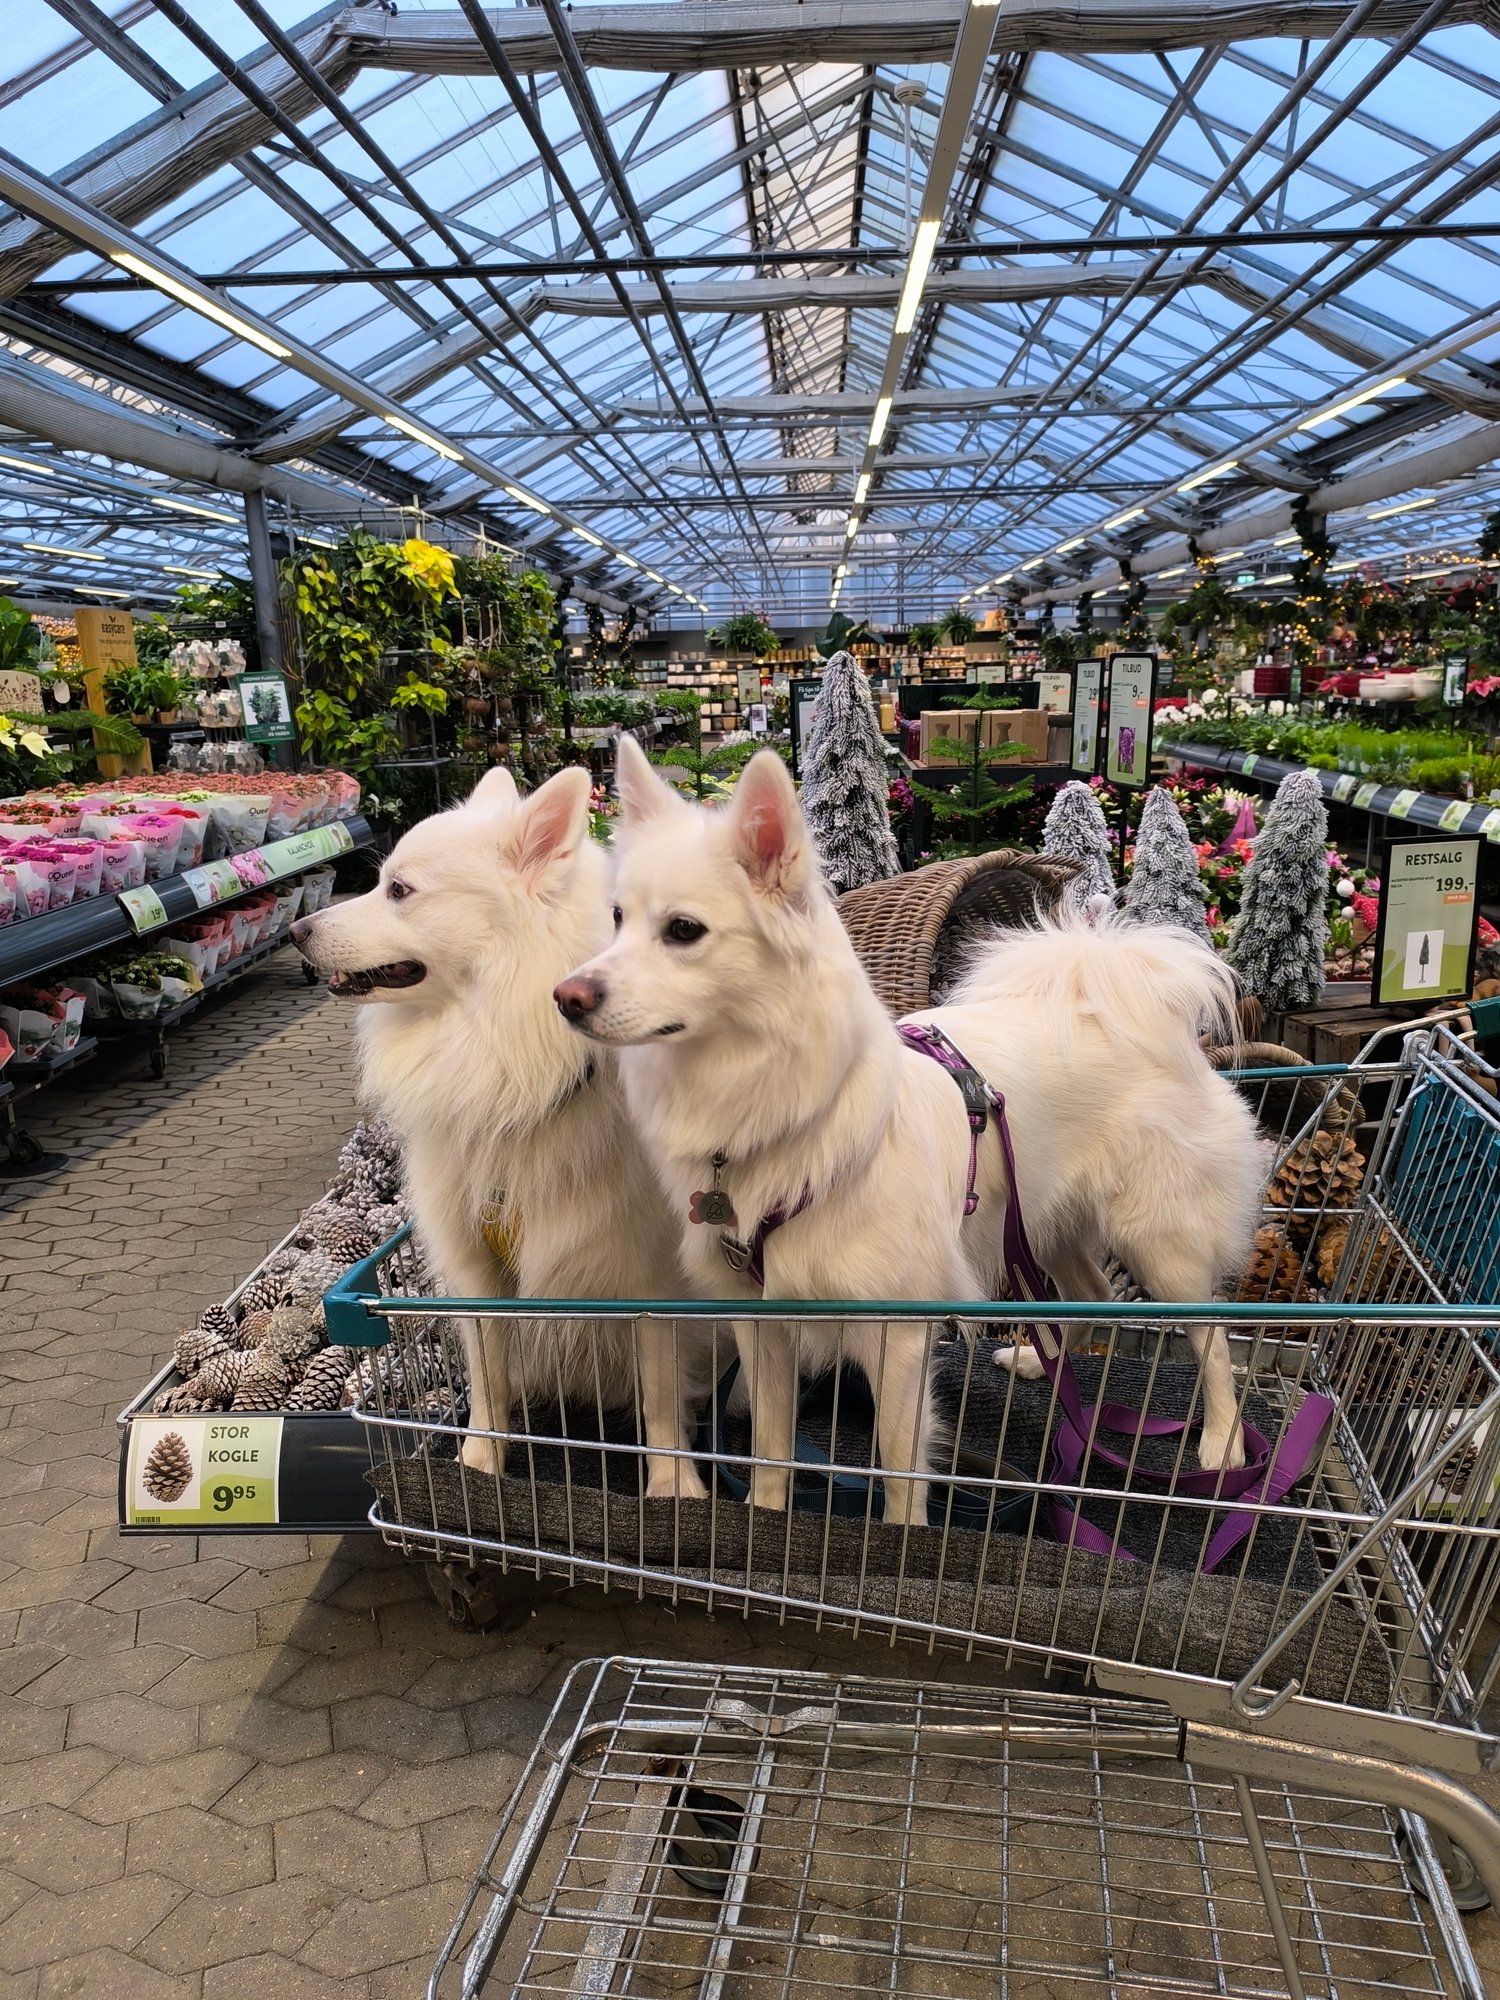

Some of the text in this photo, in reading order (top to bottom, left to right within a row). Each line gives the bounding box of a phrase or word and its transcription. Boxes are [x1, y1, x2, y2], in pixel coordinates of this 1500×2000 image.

[101, 624, 126, 636] easycare
[1122, 663, 1142, 673] TILBUD
[1405, 851, 1463, 867] RESTSALG
[210, 1426, 250, 1439] STOR
[208, 1449, 259, 1463] KOGLE
